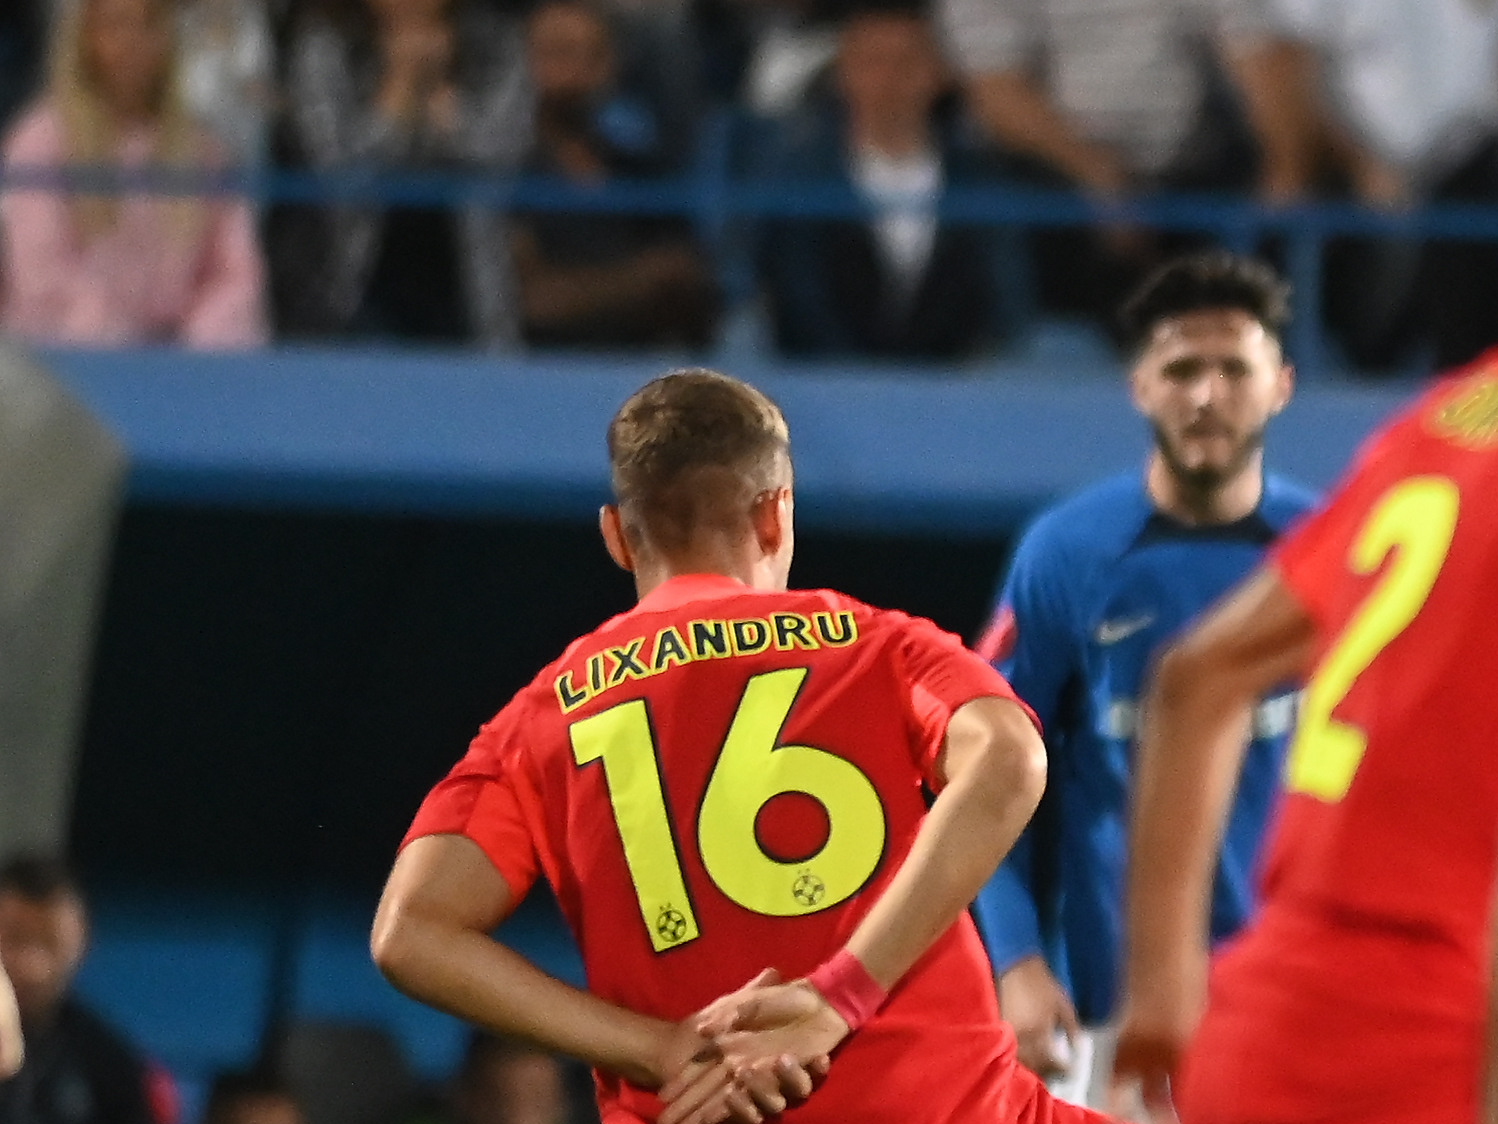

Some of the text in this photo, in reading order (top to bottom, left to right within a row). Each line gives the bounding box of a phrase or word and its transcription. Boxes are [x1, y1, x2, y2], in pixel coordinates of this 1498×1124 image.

[553, 609, 860, 715] LIXANDRU
[1288, 473, 1461, 804] 2
[568, 666, 887, 954] 16
